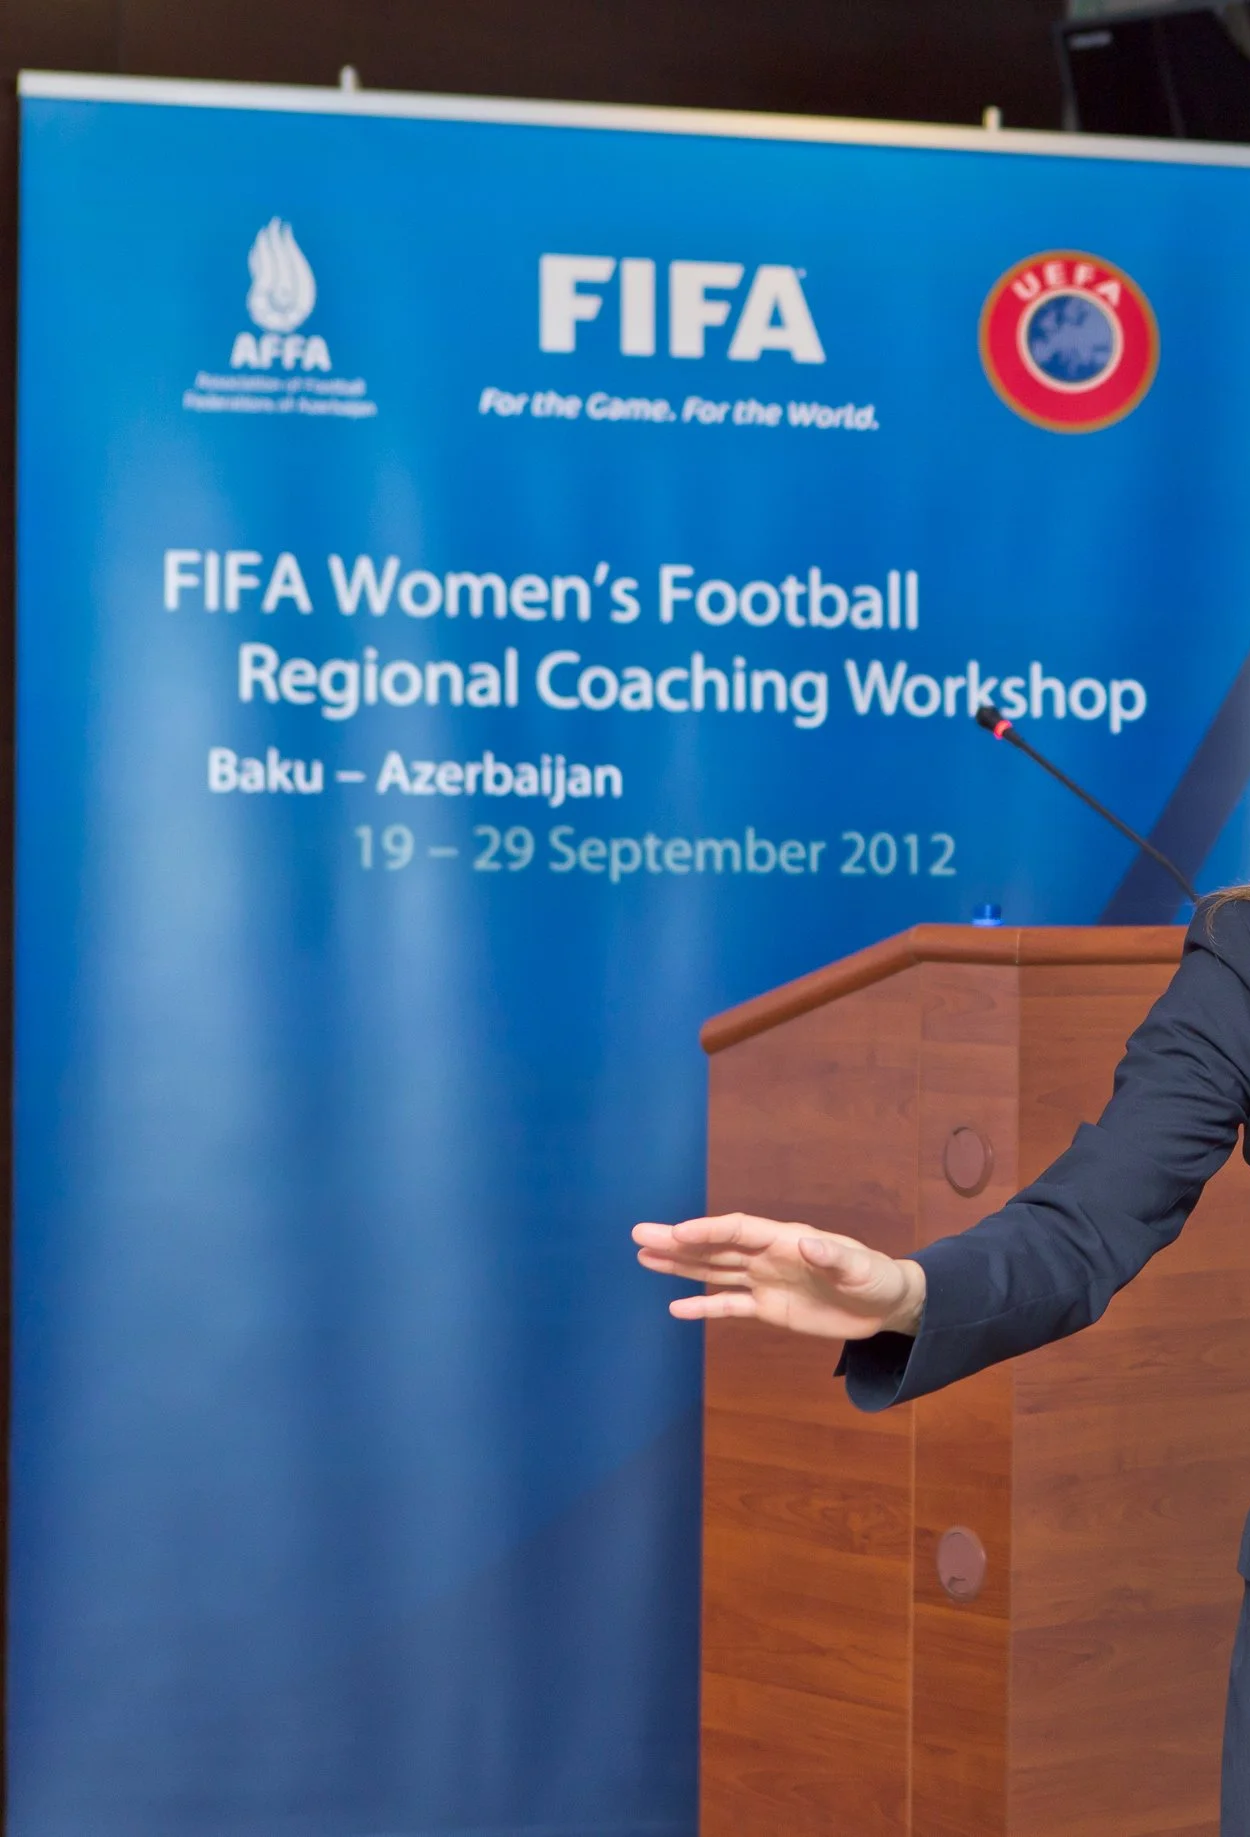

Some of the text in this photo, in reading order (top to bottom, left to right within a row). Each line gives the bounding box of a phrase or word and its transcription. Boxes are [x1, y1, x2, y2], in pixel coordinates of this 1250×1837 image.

[540, 254, 825, 363] FIFA
[1011, 260, 1121, 307] UEFA
[230, 331, 333, 372] AFFA
[479, 387, 879, 430] For the Game. For the World.
[164, 550, 312, 613] FIFA
[660, 565, 917, 629] Football
[238, 642, 1148, 735] Regional Coaching Workshop
[209, 748, 323, 793] Baku
[377, 752, 622, 806] Azerbaijan
[357, 826, 414, 869] 19
[473, 826, 534, 871] 29
[550, 826, 825, 882] September
[841, 832, 955, 875] 2012
